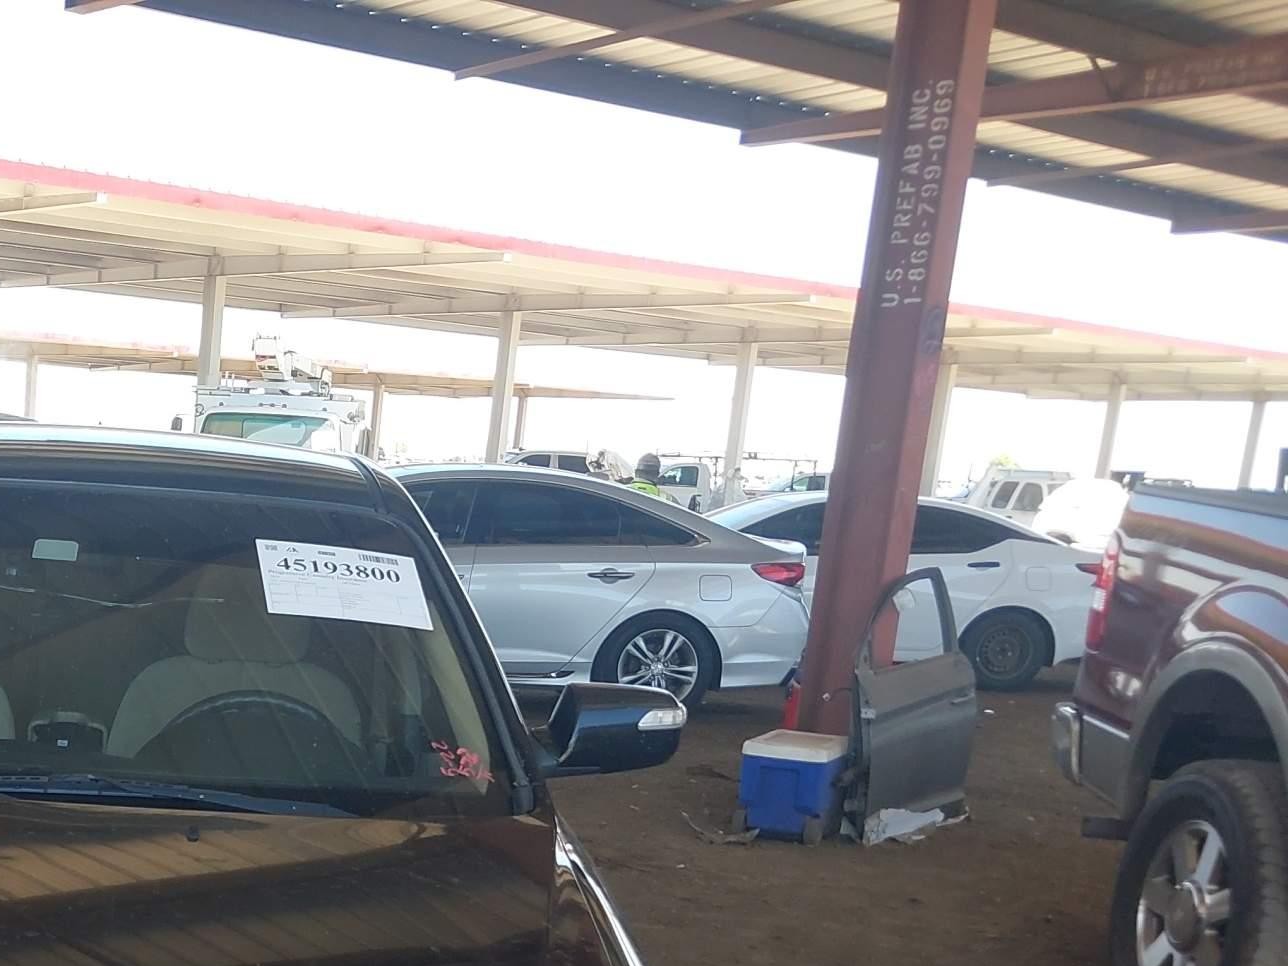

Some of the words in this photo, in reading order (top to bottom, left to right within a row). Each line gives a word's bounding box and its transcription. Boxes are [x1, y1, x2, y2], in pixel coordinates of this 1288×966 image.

[891, 143, 923, 244] PREFAB
[903, 79, 955, 305] 1-866-799-0969
[881, 260, 906, 308] U.S.
[276, 556, 401, 584] 45193800
